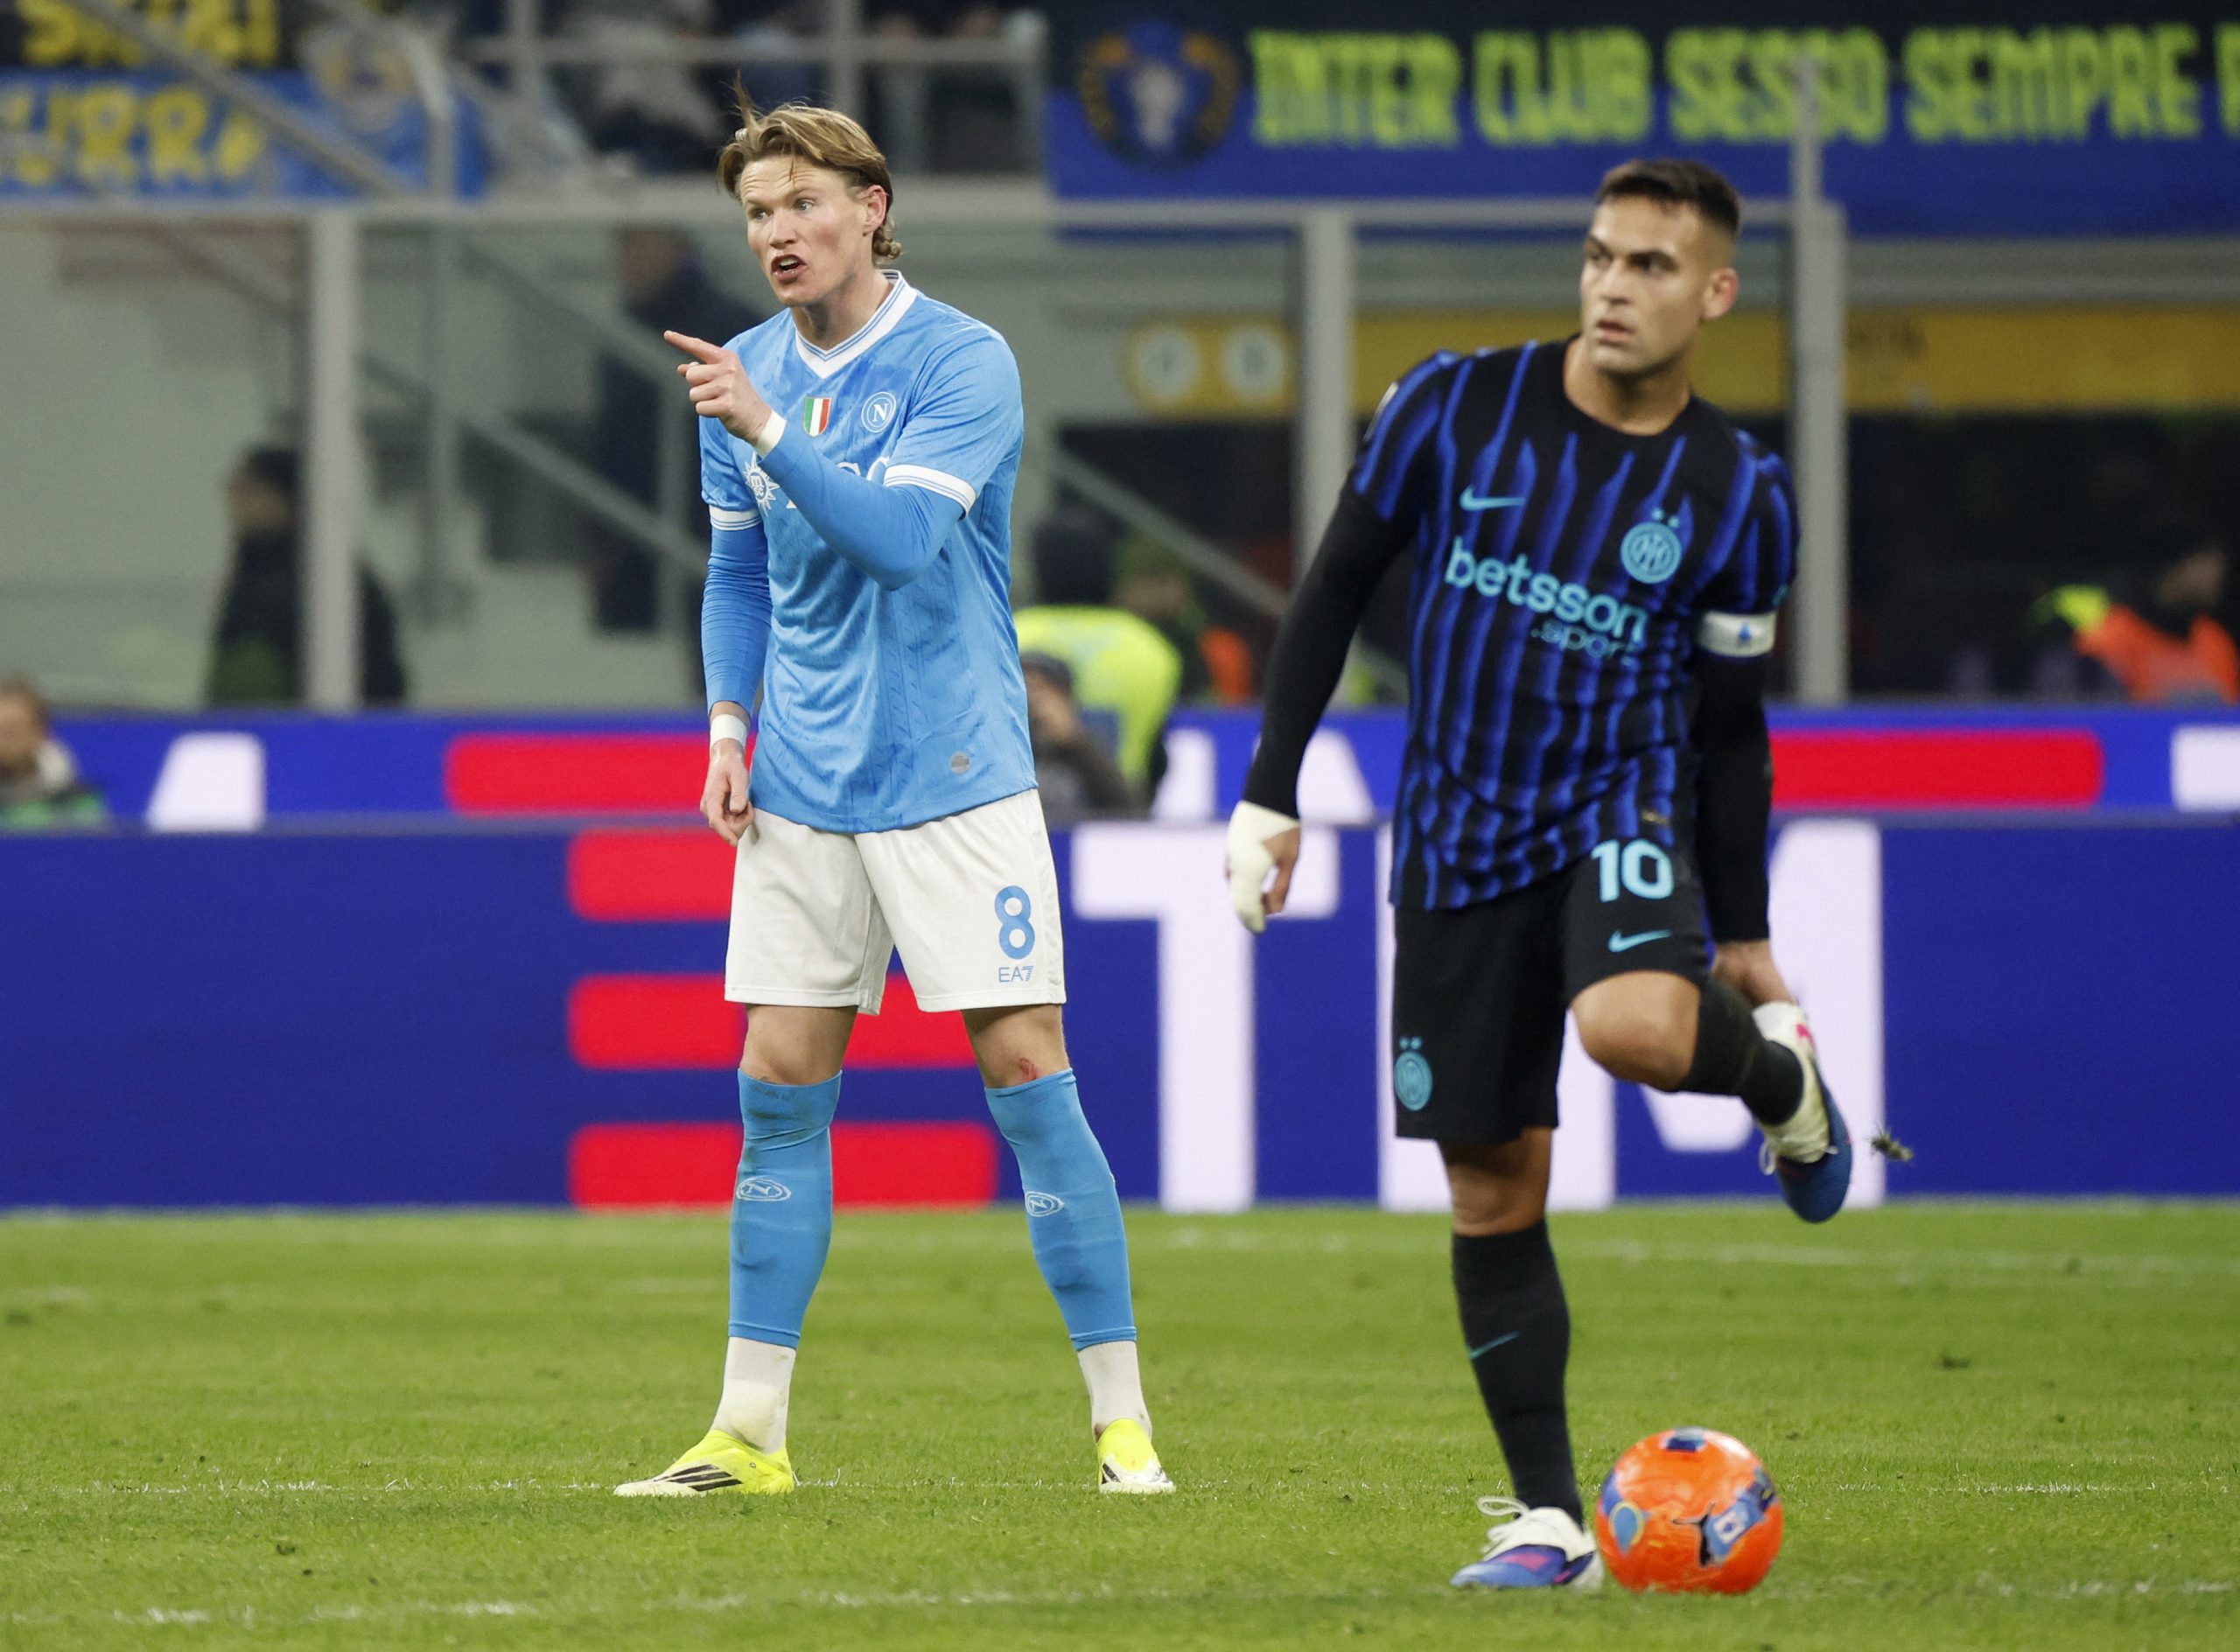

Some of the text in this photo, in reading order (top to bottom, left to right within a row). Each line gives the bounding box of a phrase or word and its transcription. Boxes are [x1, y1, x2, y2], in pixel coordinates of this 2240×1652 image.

[1250, 29, 1462, 148] INTER
[1474, 27, 1653, 147] CLUB
[1901, 24, 2201, 142] SEMPRE
[872, 402, 890, 423] N
[1445, 536, 1648, 646] betsson
[1591, 839, 1675, 903] 10
[995, 886, 1035, 960] 8
[998, 965, 1033, 983] EA7
